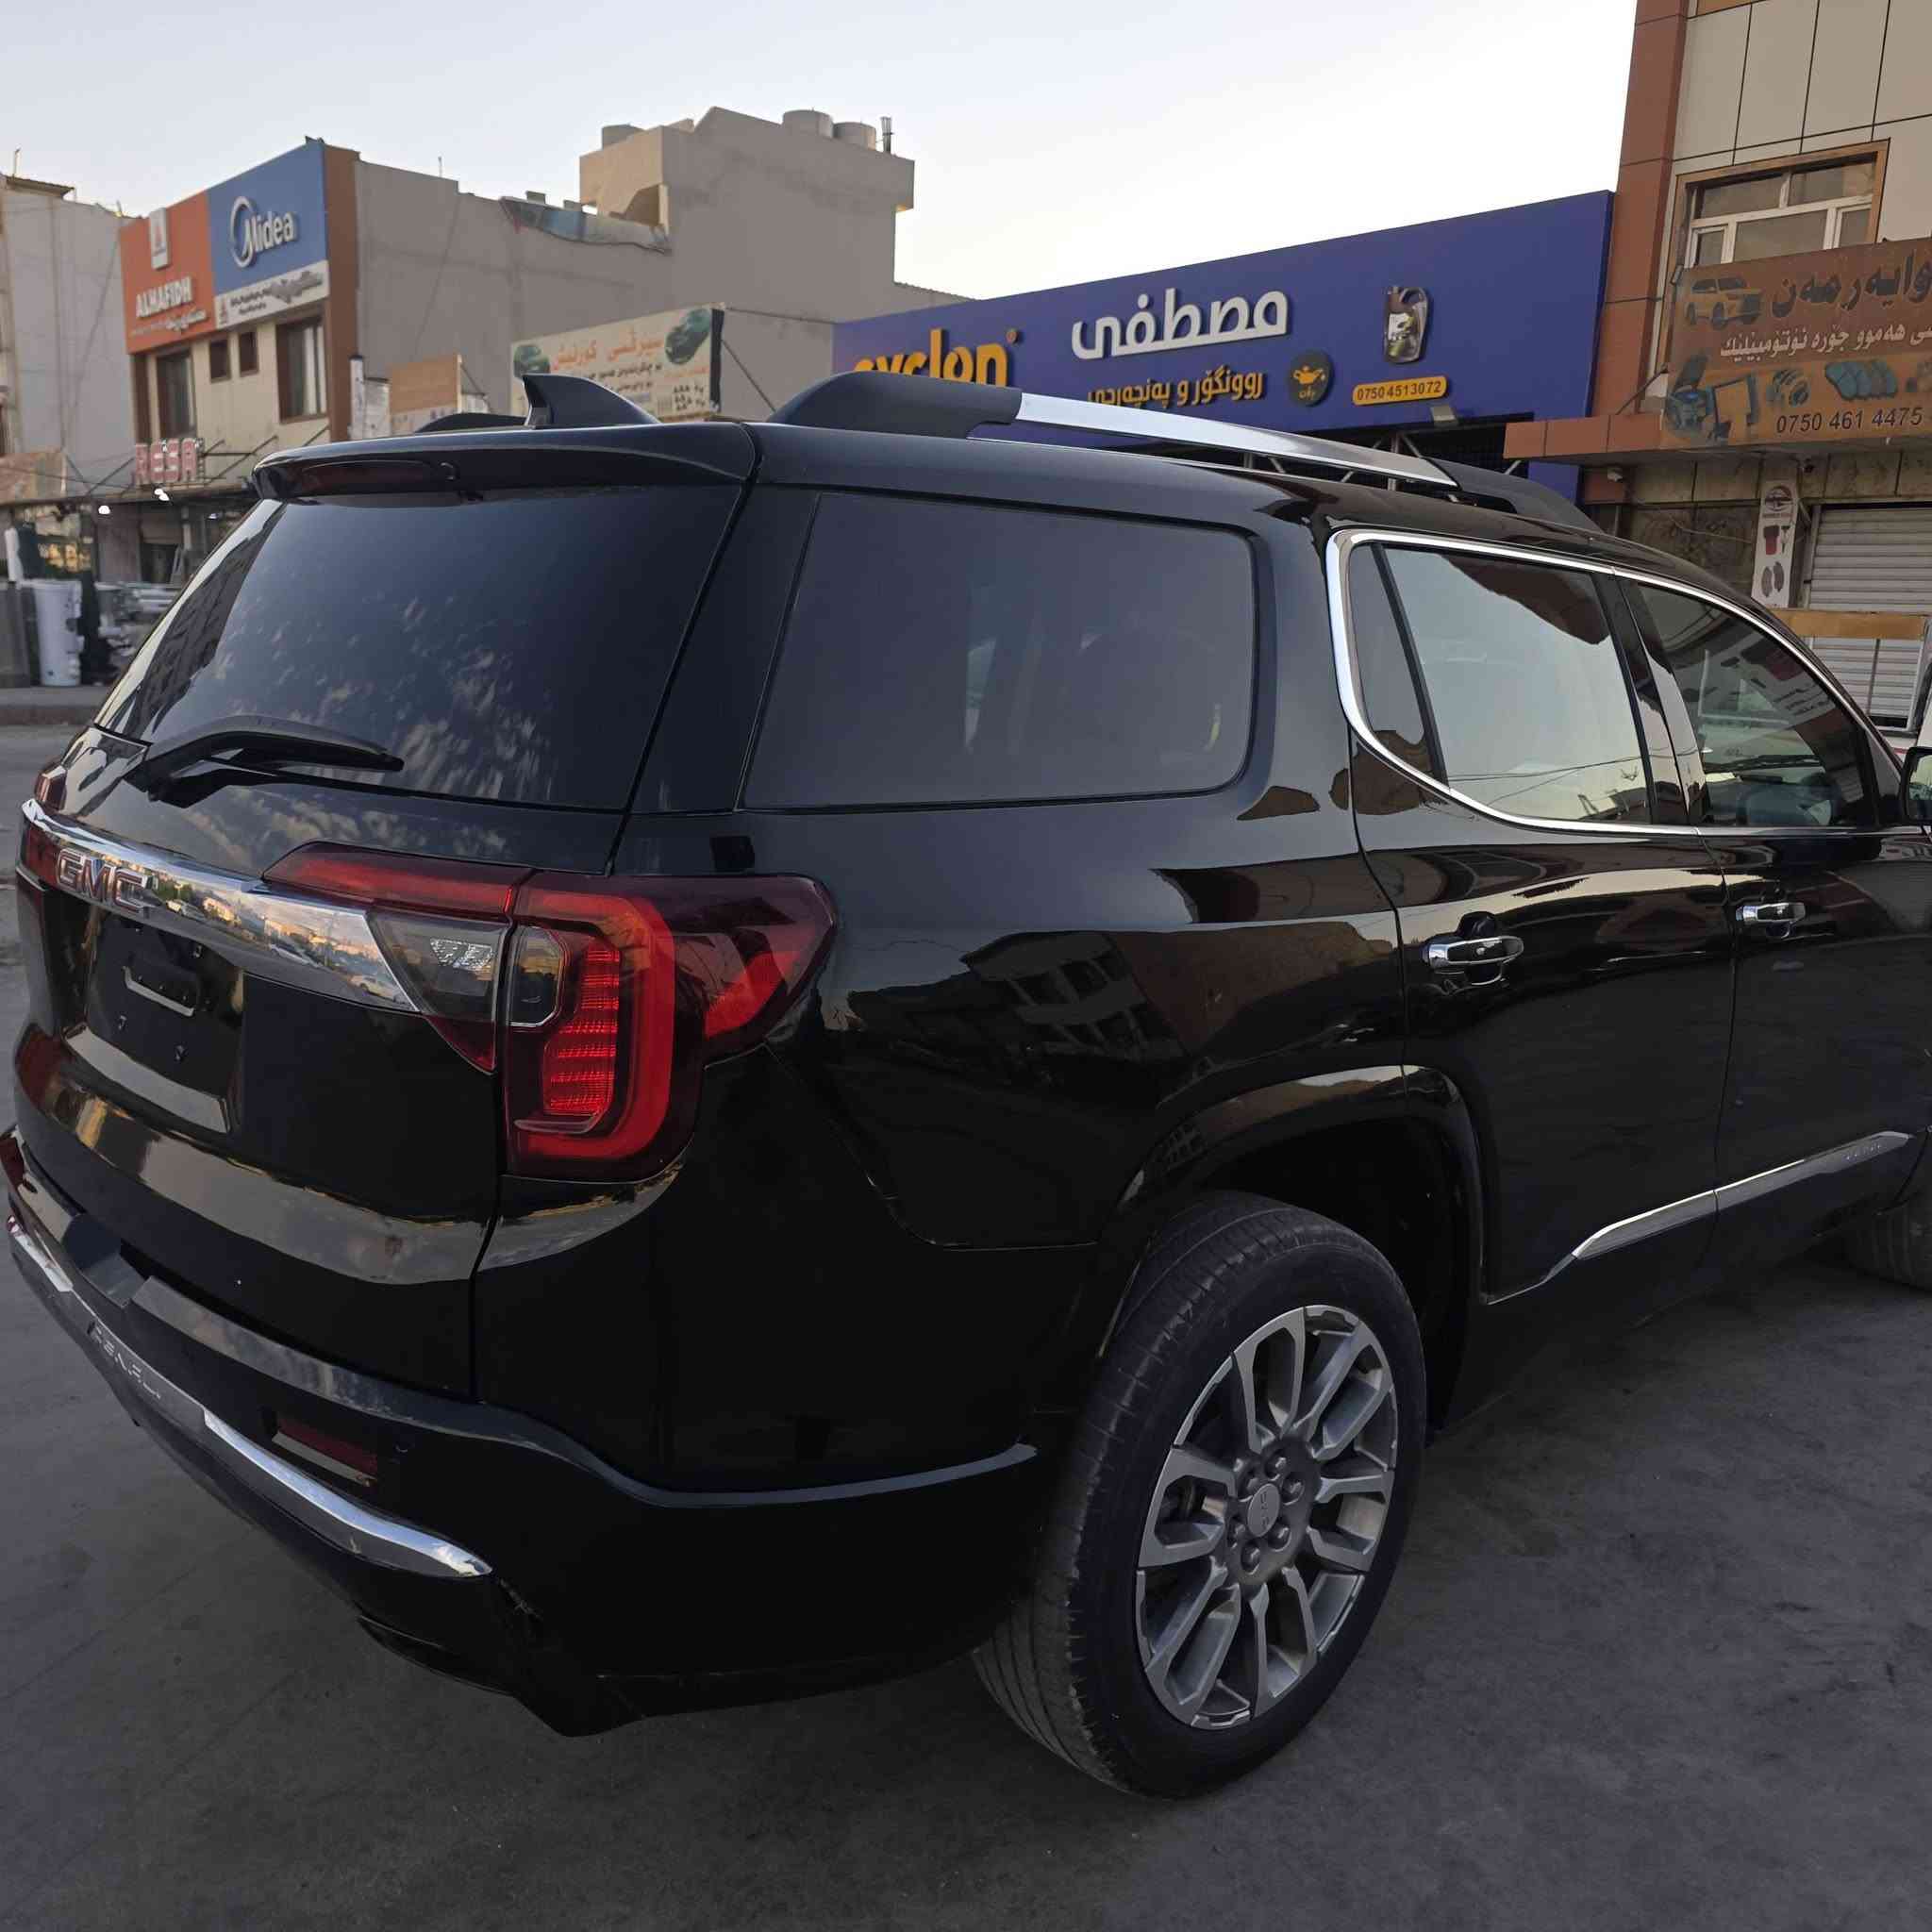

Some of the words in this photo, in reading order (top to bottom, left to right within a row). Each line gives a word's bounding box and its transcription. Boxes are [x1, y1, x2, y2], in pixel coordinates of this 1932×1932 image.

[230, 196, 296, 268] Midea
[1177, 377, 1189, 405] و
[1776, 412, 1822, 433] 0750
[1829, 409, 1864, 429] 461
[1872, 407, 1924, 427] 4475
[56, 847, 149, 913] GMC
